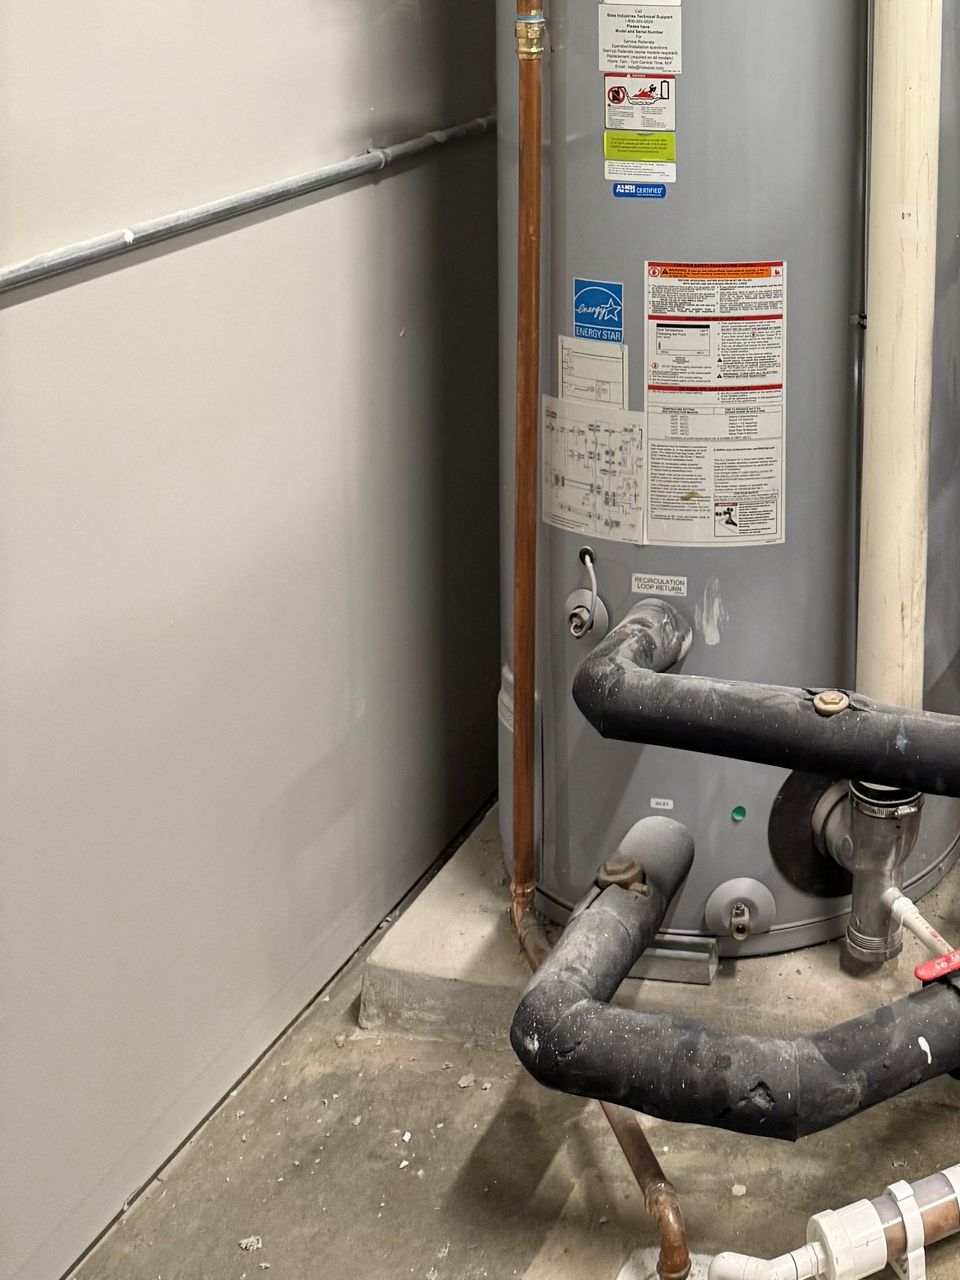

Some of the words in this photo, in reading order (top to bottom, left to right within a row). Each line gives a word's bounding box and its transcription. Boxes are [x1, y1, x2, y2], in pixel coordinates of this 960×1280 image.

[576, 326, 602, 338] ENERGY
[602, 330, 621, 340] STAR
[634, 576, 685, 586] RECIRCULATION
[655, 584, 682, 592] RETURN
